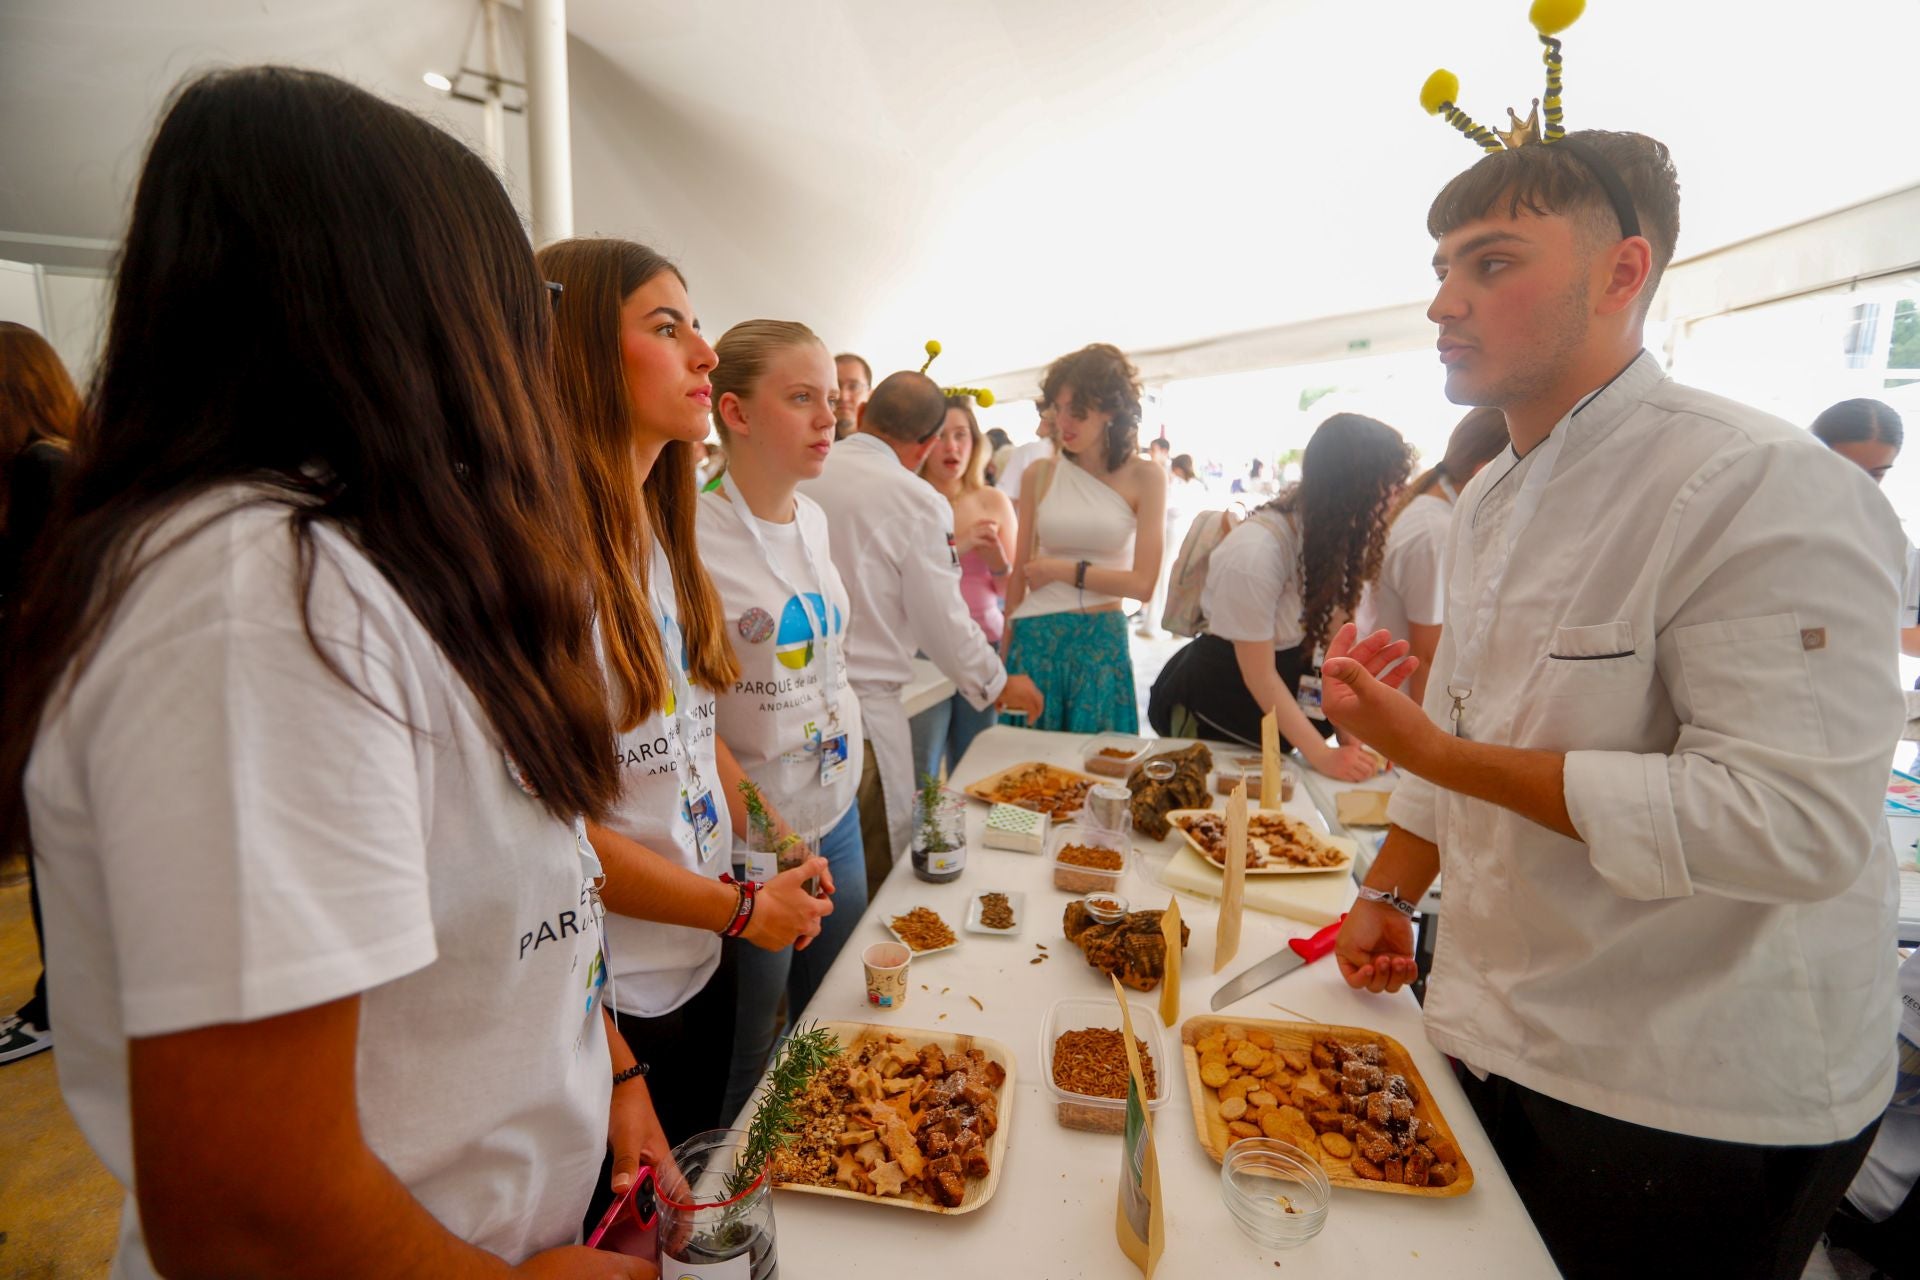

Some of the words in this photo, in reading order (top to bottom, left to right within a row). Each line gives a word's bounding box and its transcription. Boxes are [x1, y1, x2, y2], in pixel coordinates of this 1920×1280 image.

[735, 678, 793, 697] PARQUE
[795, 679, 805, 690] de
[614, 737, 669, 768] PARQ
[519, 910, 579, 960] PAR
